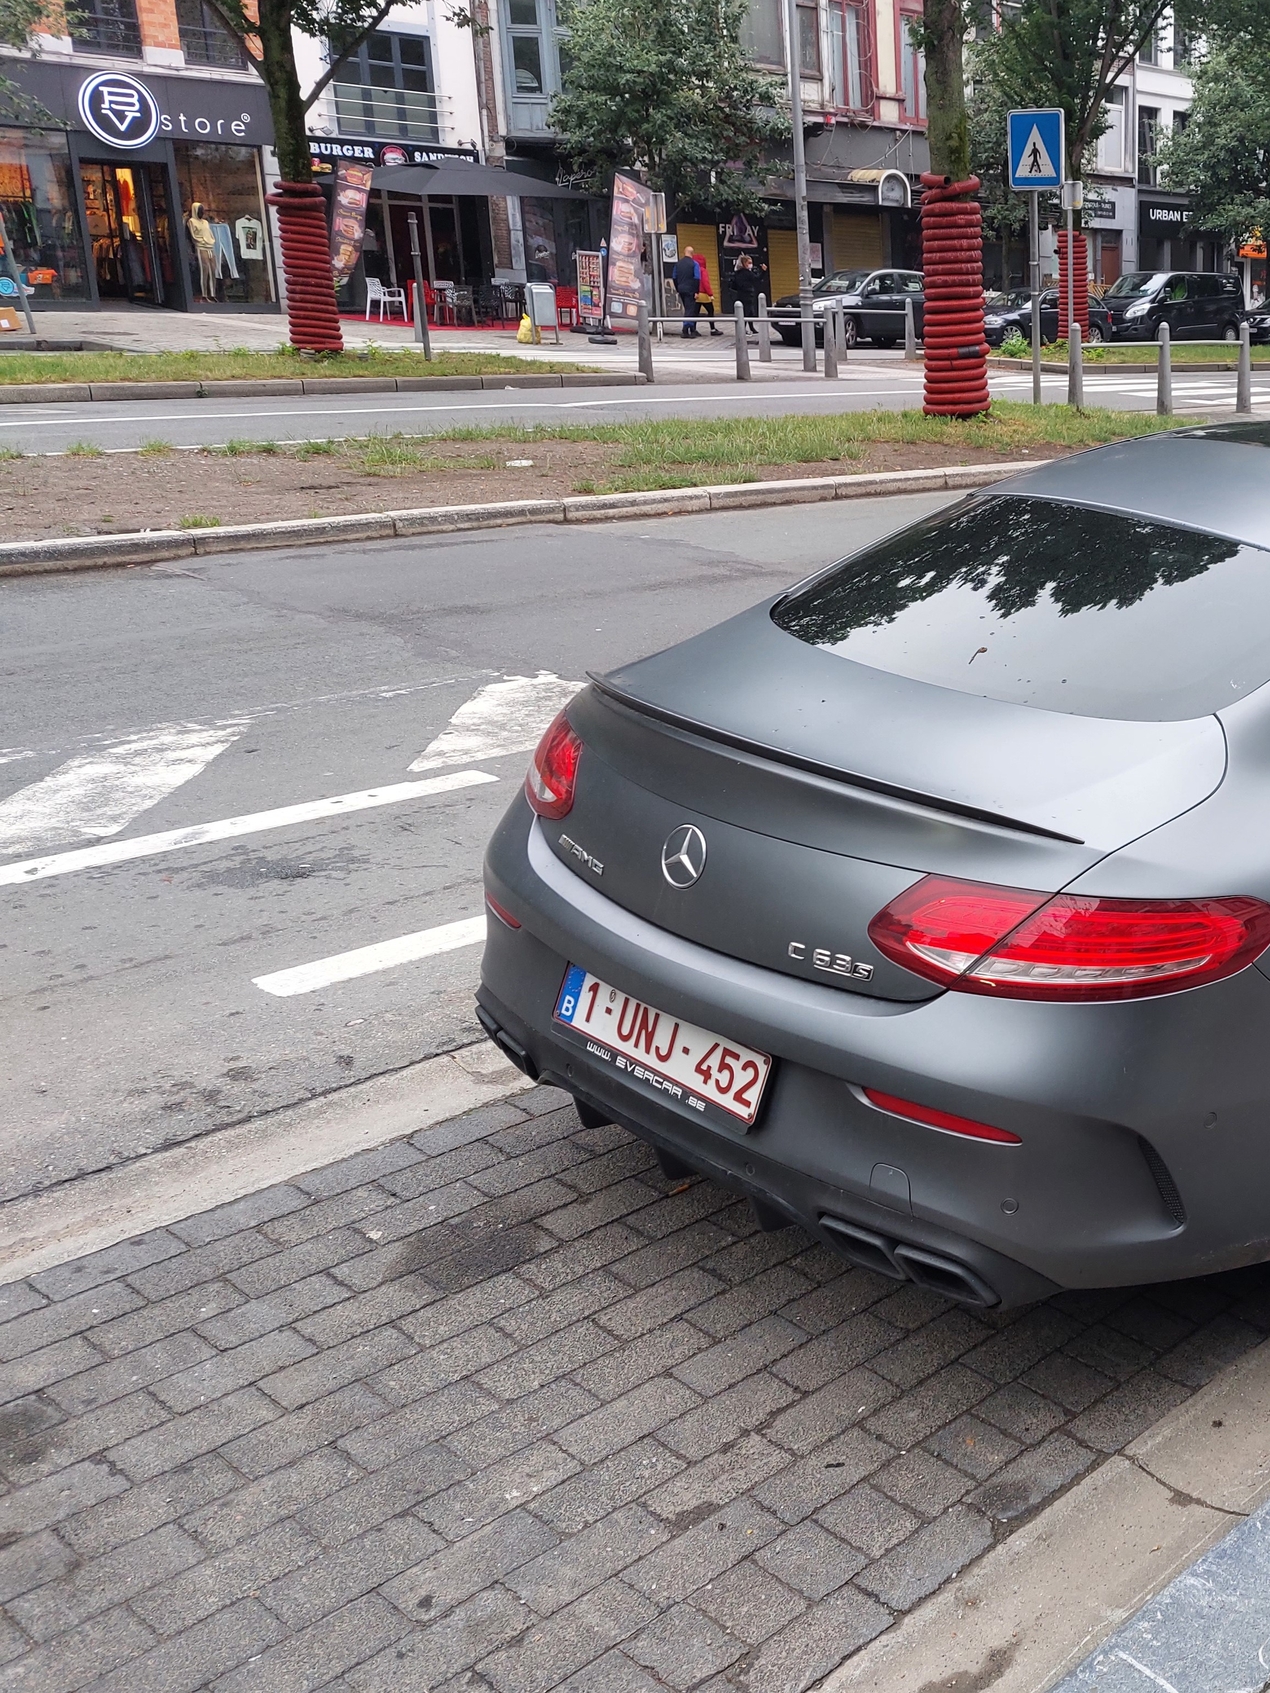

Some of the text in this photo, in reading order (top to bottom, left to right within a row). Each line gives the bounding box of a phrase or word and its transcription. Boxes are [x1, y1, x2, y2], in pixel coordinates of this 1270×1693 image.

[309, 142, 375, 159] BURGER
[1150, 208, 1180, 221] URBAN
[718, 223, 759, 237] FRIAY
[788, 942, 806, 960] C
[561, 982, 760, 1109] B 1-UNJ-452
